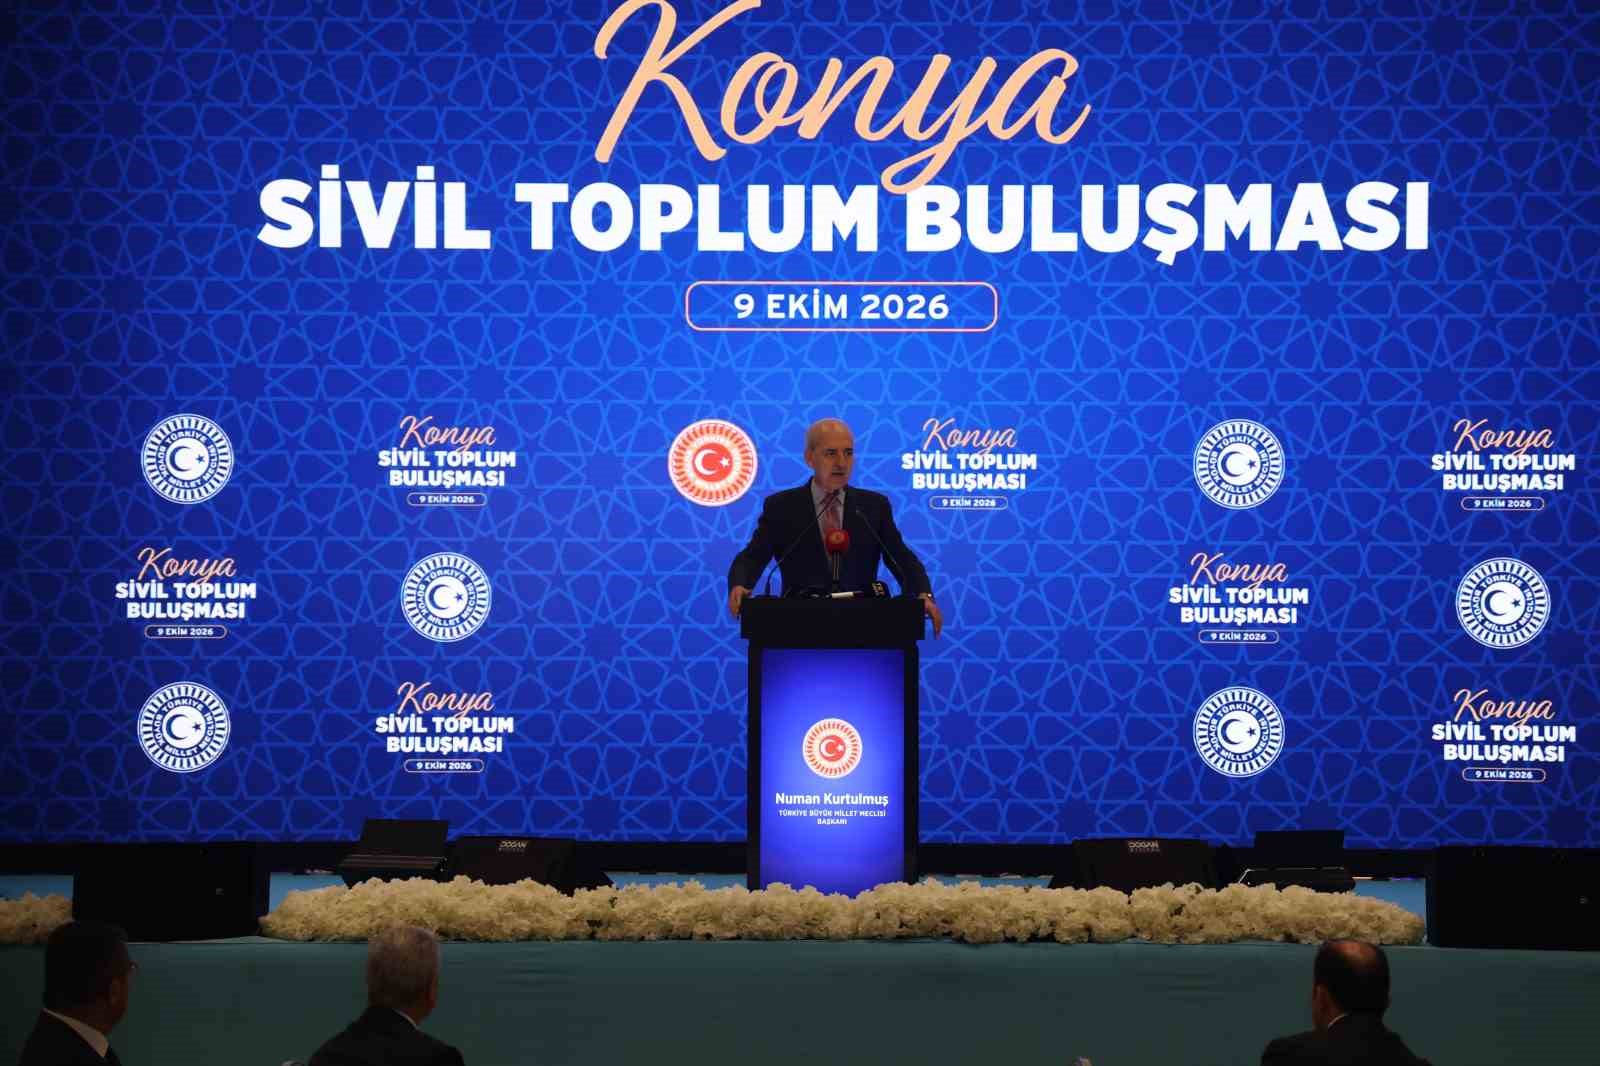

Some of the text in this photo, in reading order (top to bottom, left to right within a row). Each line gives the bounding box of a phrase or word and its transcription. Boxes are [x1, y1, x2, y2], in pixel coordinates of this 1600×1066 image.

[594, 0, 1092, 194] Konya
[257, 164, 1429, 266] SİVİL TOPLUM BULUŞMASI
[735, 288, 949, 320] 9 EKİM 2026
[400, 415, 496, 453] Konya
[923, 418, 1018, 455] Konya
[1454, 418, 1554, 456] Konya
[378, 448, 516, 467] SİVİL TOPLUM
[902, 450, 1037, 470] SİVİL TOPLUM
[1431, 451, 1575, 470] SİVİL TOPLUM
[390, 470, 505, 488] BULUŞMASI
[912, 472, 1026, 492] BULUŞMASI
[1443, 474, 1564, 492] BULUŞMASI
[428, 494, 449, 503] EKİM
[1482, 499, 1505, 507] EKİM
[138, 547, 236, 584] Konya
[1190, 552, 1288, 590] Konya
[115, 579, 256, 599] SİVİL TOPLUM
[1169, 584, 1309, 604] SİVİL TOPLUM
[127, 602, 245, 621] BULUŞMASI
[1180, 607, 1297, 626] BULUŞMASI
[166, 627, 188, 636] EKİM
[1219, 632, 1241, 640] EKİM
[397, 682, 496, 719] Konya
[1454, 689, 1555, 728] Konya
[376, 713, 514, 733] SİVİL TOPLUM
[1432, 721, 1576, 742] SİVİL TOPLUM
[386, 736, 503, 755] BULUŞMASI
[1444, 744, 1565, 764] BULUŞMASI
[416, 762, 472, 770] 9 EKİM 2026
[1484, 770, 1506, 778] EKİM
[1508, 771, 1533, 779] 2026
[776, 792, 888, 806] Numan Kurtulmuş
